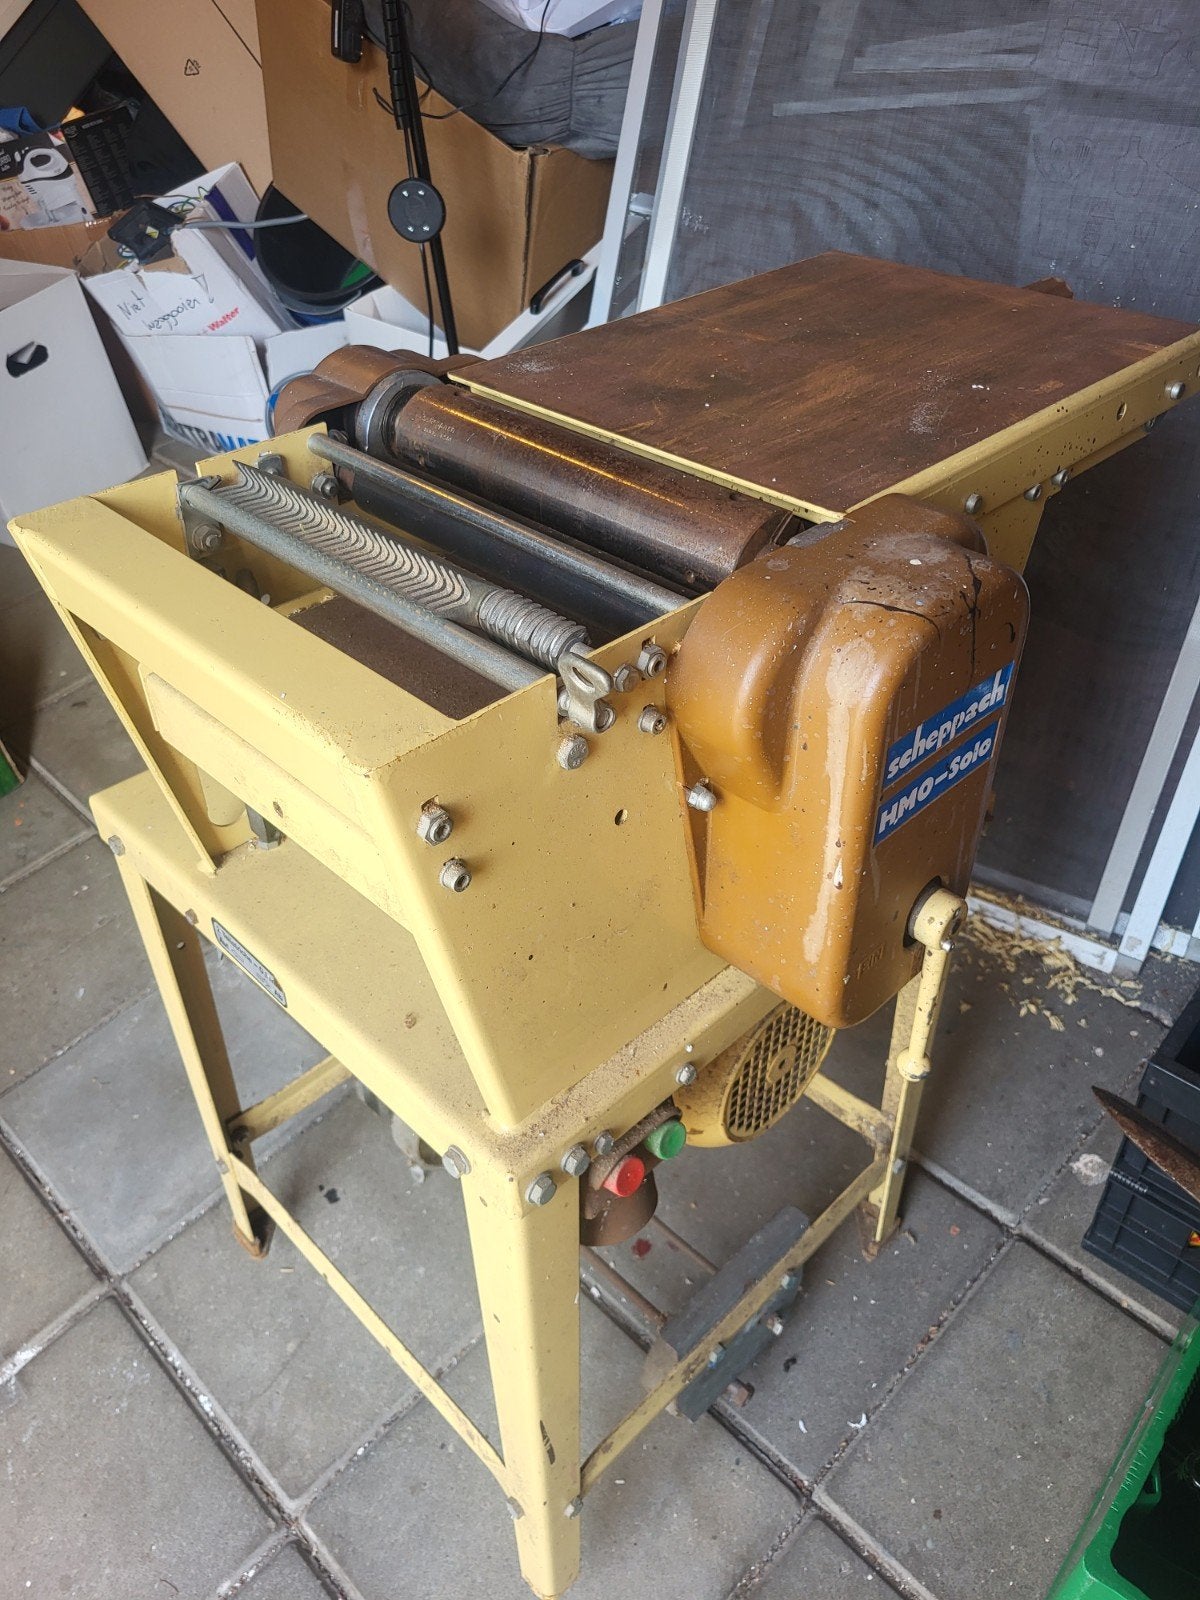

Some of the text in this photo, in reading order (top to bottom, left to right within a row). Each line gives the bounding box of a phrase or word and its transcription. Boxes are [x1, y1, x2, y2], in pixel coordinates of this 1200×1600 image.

[117, 289, 146, 320] Niet
[886, 668, 1005, 780] scheppach
[878, 737, 992, 834] HMO-Solo
